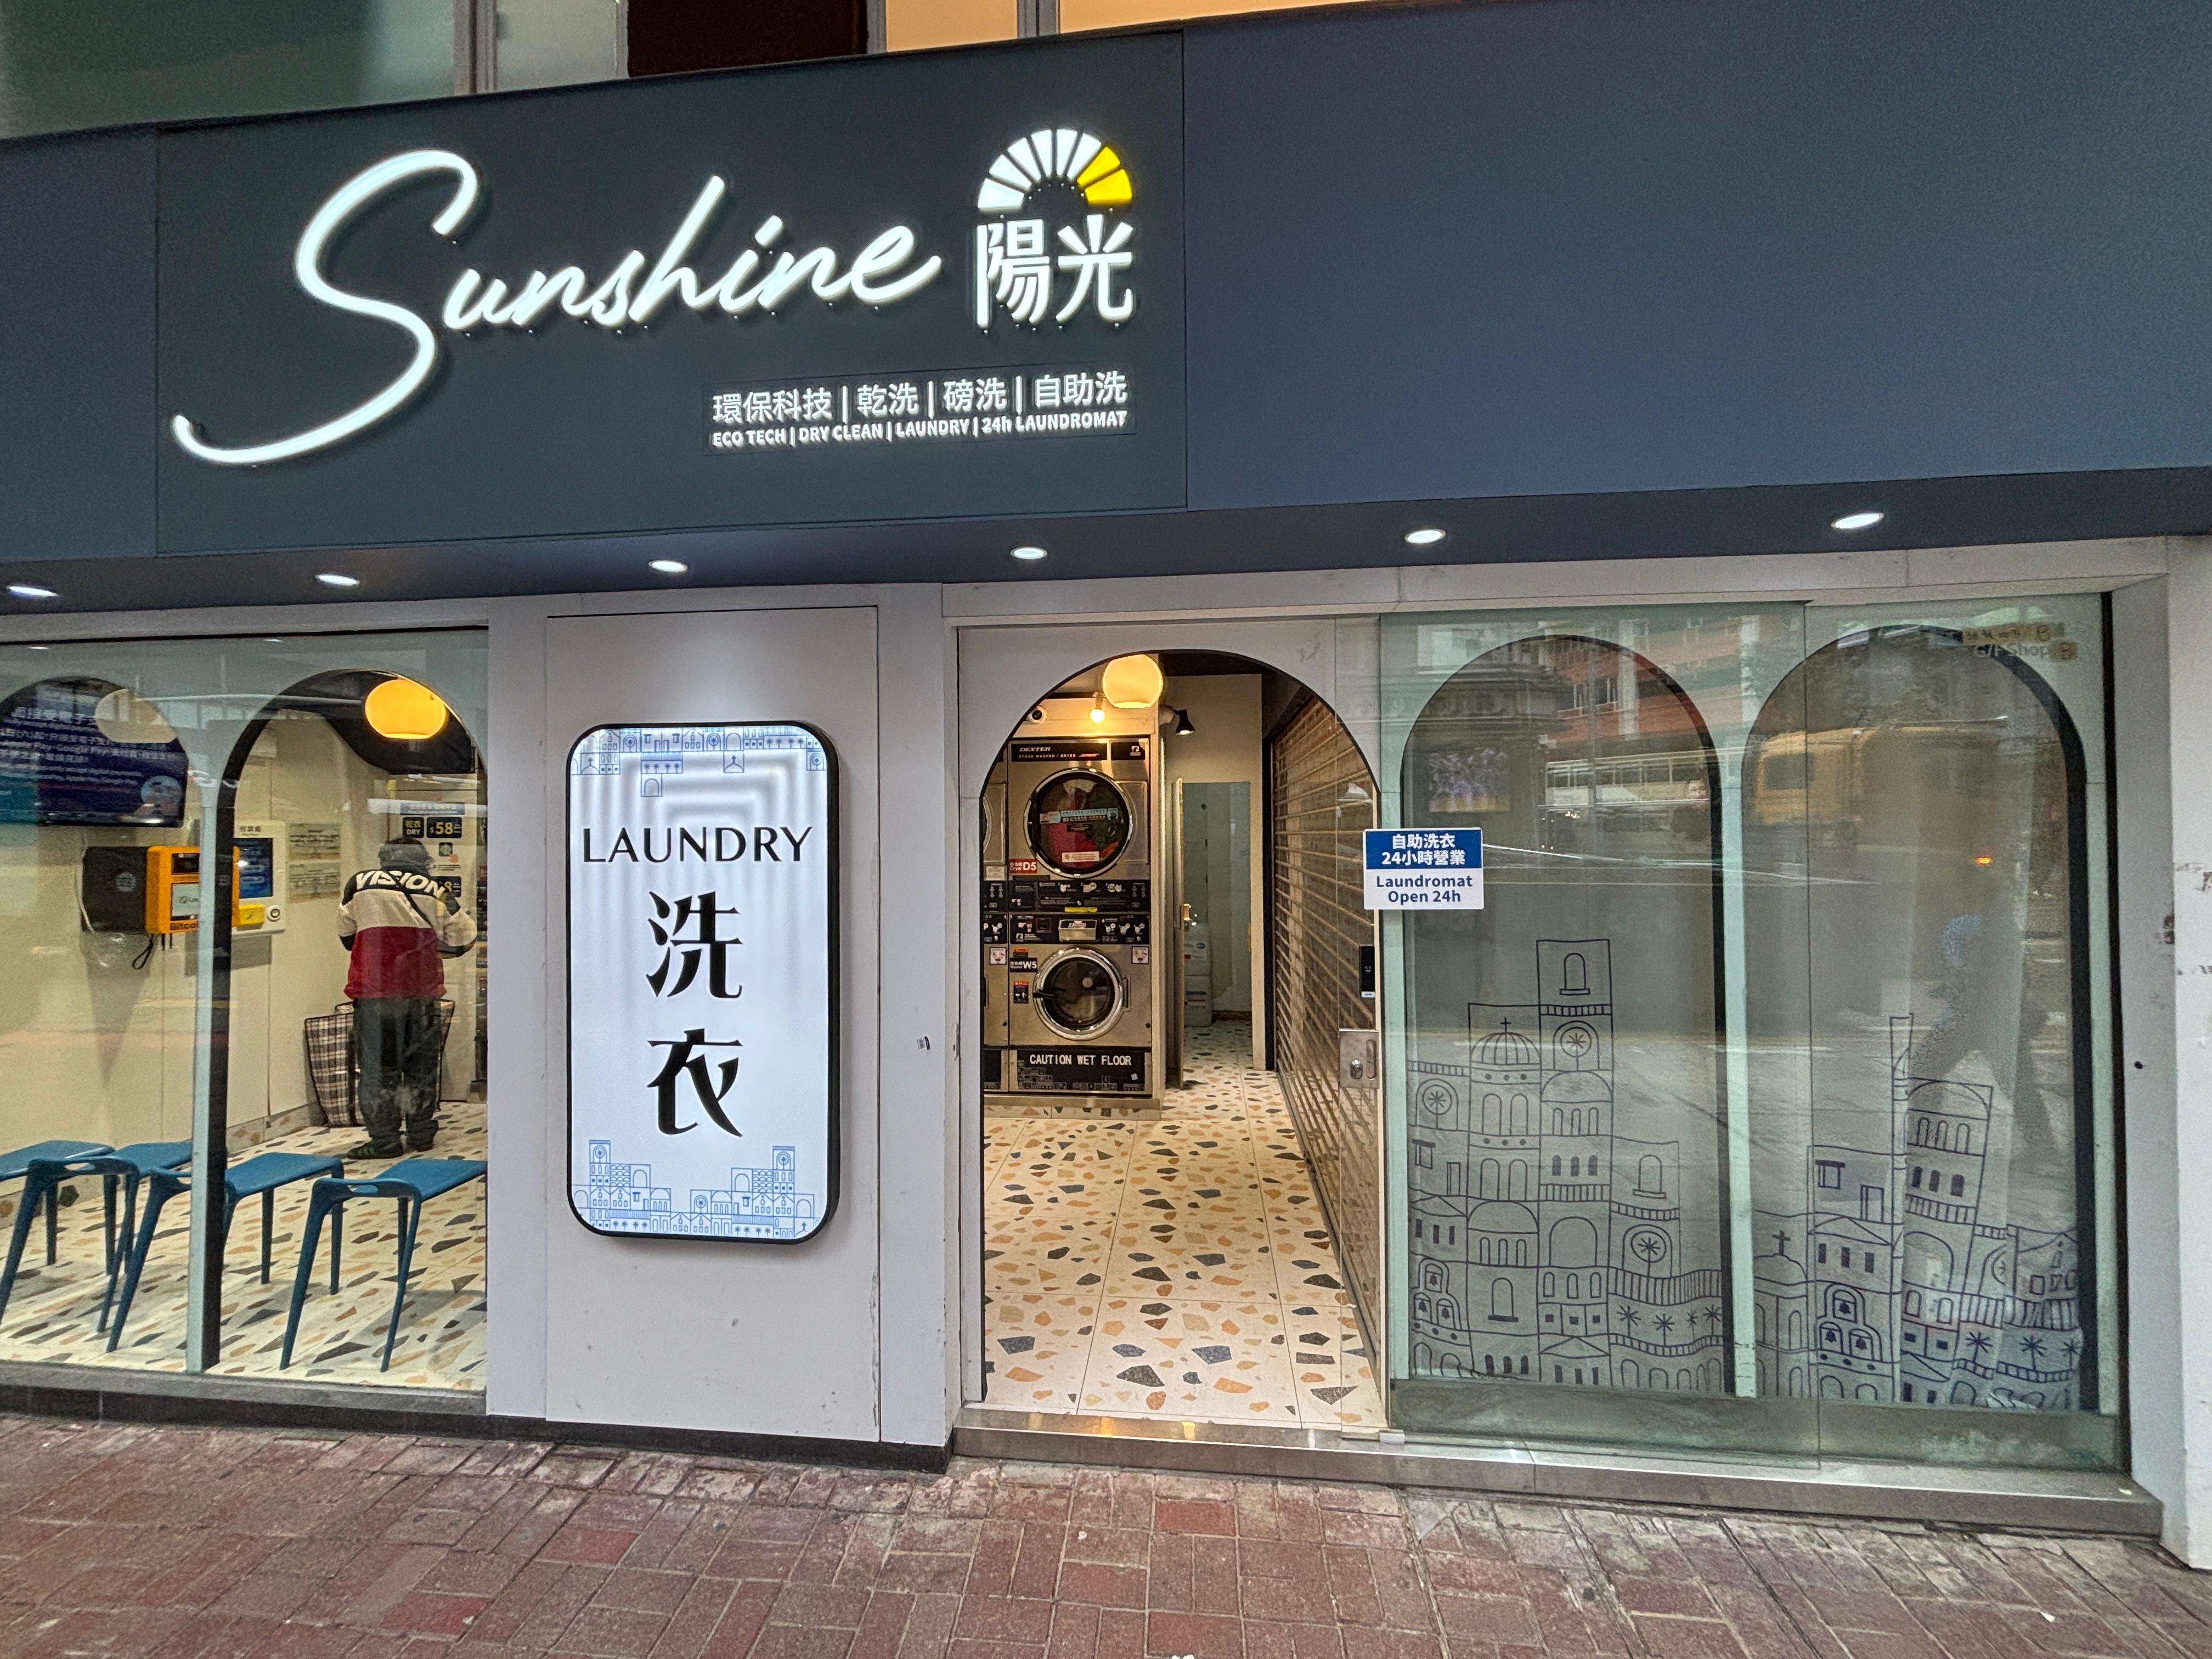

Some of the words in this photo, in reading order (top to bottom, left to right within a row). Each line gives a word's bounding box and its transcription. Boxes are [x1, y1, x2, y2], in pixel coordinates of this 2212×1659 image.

[976, 214, 1133, 328] 陽光
[171, 148, 943, 465] Sunshine
[712, 387, 833, 424] 環保科技
[856, 382, 919, 417] 乾洗
[943, 377, 1007, 412] 磅洗
[1035, 370, 1127, 409] 自助洗
[713, 432, 743, 447] ECO
[745, 428, 787, 444] TECH
[798, 426, 831, 442] DRY
[832, 424, 883, 439] CLEAN
[895, 419, 970, 438] LAUNDRY
[981, 416, 1012, 434] 24h
[1015, 410, 1128, 432] LAUNDROMAT
[583, 826, 812, 863] LAUNDRY
[1392, 833, 1455, 850] 自助洗衣
[1023, 862, 1037, 871] D5
[1381, 850, 1465, 866] 24小時營業
[356, 870, 445, 899] VISION
[1376, 875, 1473, 888] Laundromat
[1388, 890, 1429, 905] Open
[1432, 890, 1461, 902] 24h
[1023, 961, 1037, 969] W5
[645, 890, 743, 1138] 洗衣
[1030, 1054, 1072, 1065] CAUTION
[1077, 1055, 1096, 1065] WET
[1101, 1055, 1132, 1066] FLOOR
